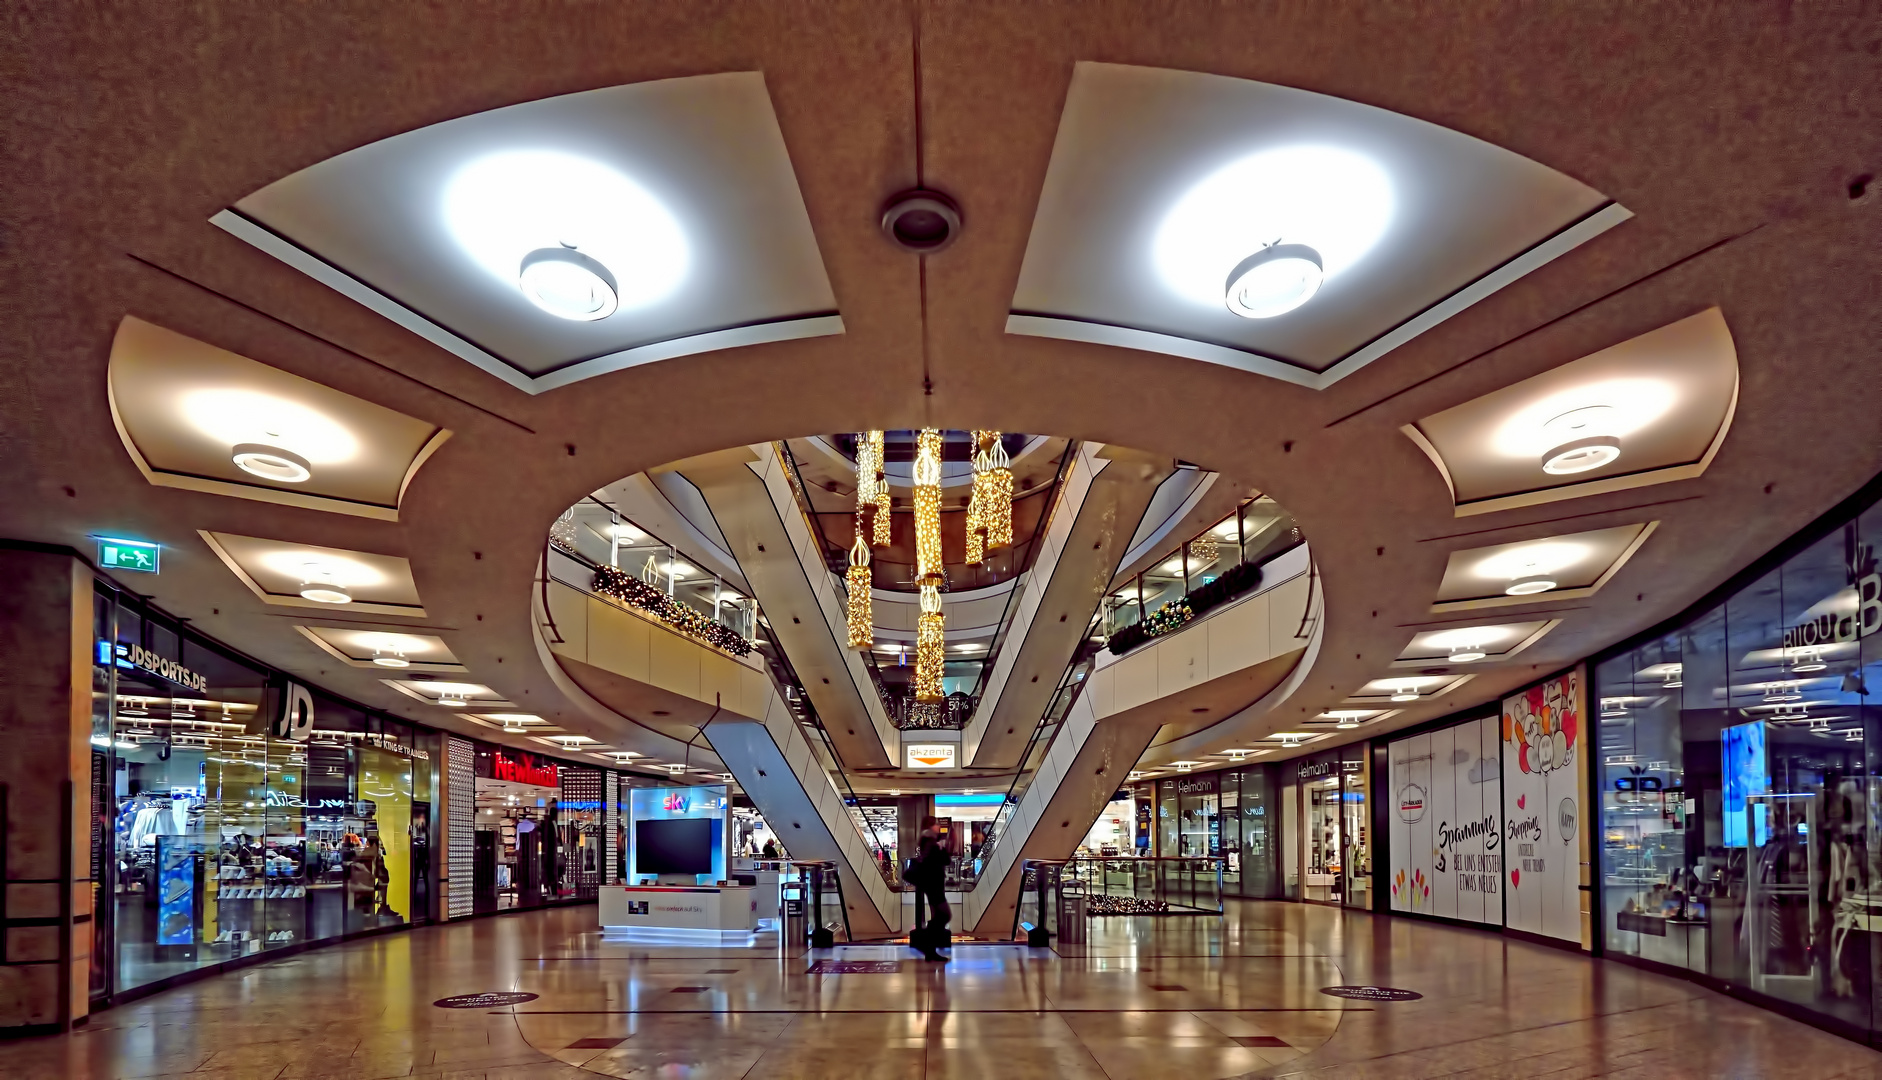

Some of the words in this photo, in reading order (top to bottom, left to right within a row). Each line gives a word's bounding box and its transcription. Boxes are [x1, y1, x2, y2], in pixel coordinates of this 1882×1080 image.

[128, 643, 206, 693] JDSPORTS.DE
[279, 680, 314, 741] JD
[383, 740, 398, 752] KING
[910, 748, 953, 756] akzenta
[663, 792, 691, 813] sky
[1507, 816, 1542, 841] Shopping
[1561, 811, 1575, 829] HAPPY
[1438, 814, 1499, 852] Spannung
[1453, 854, 1463, 871] BEI
[1464, 855, 1476, 872] UNS
[1459, 873, 1477, 892] ETWAS
[1478, 875, 1497, 894] NEUES
